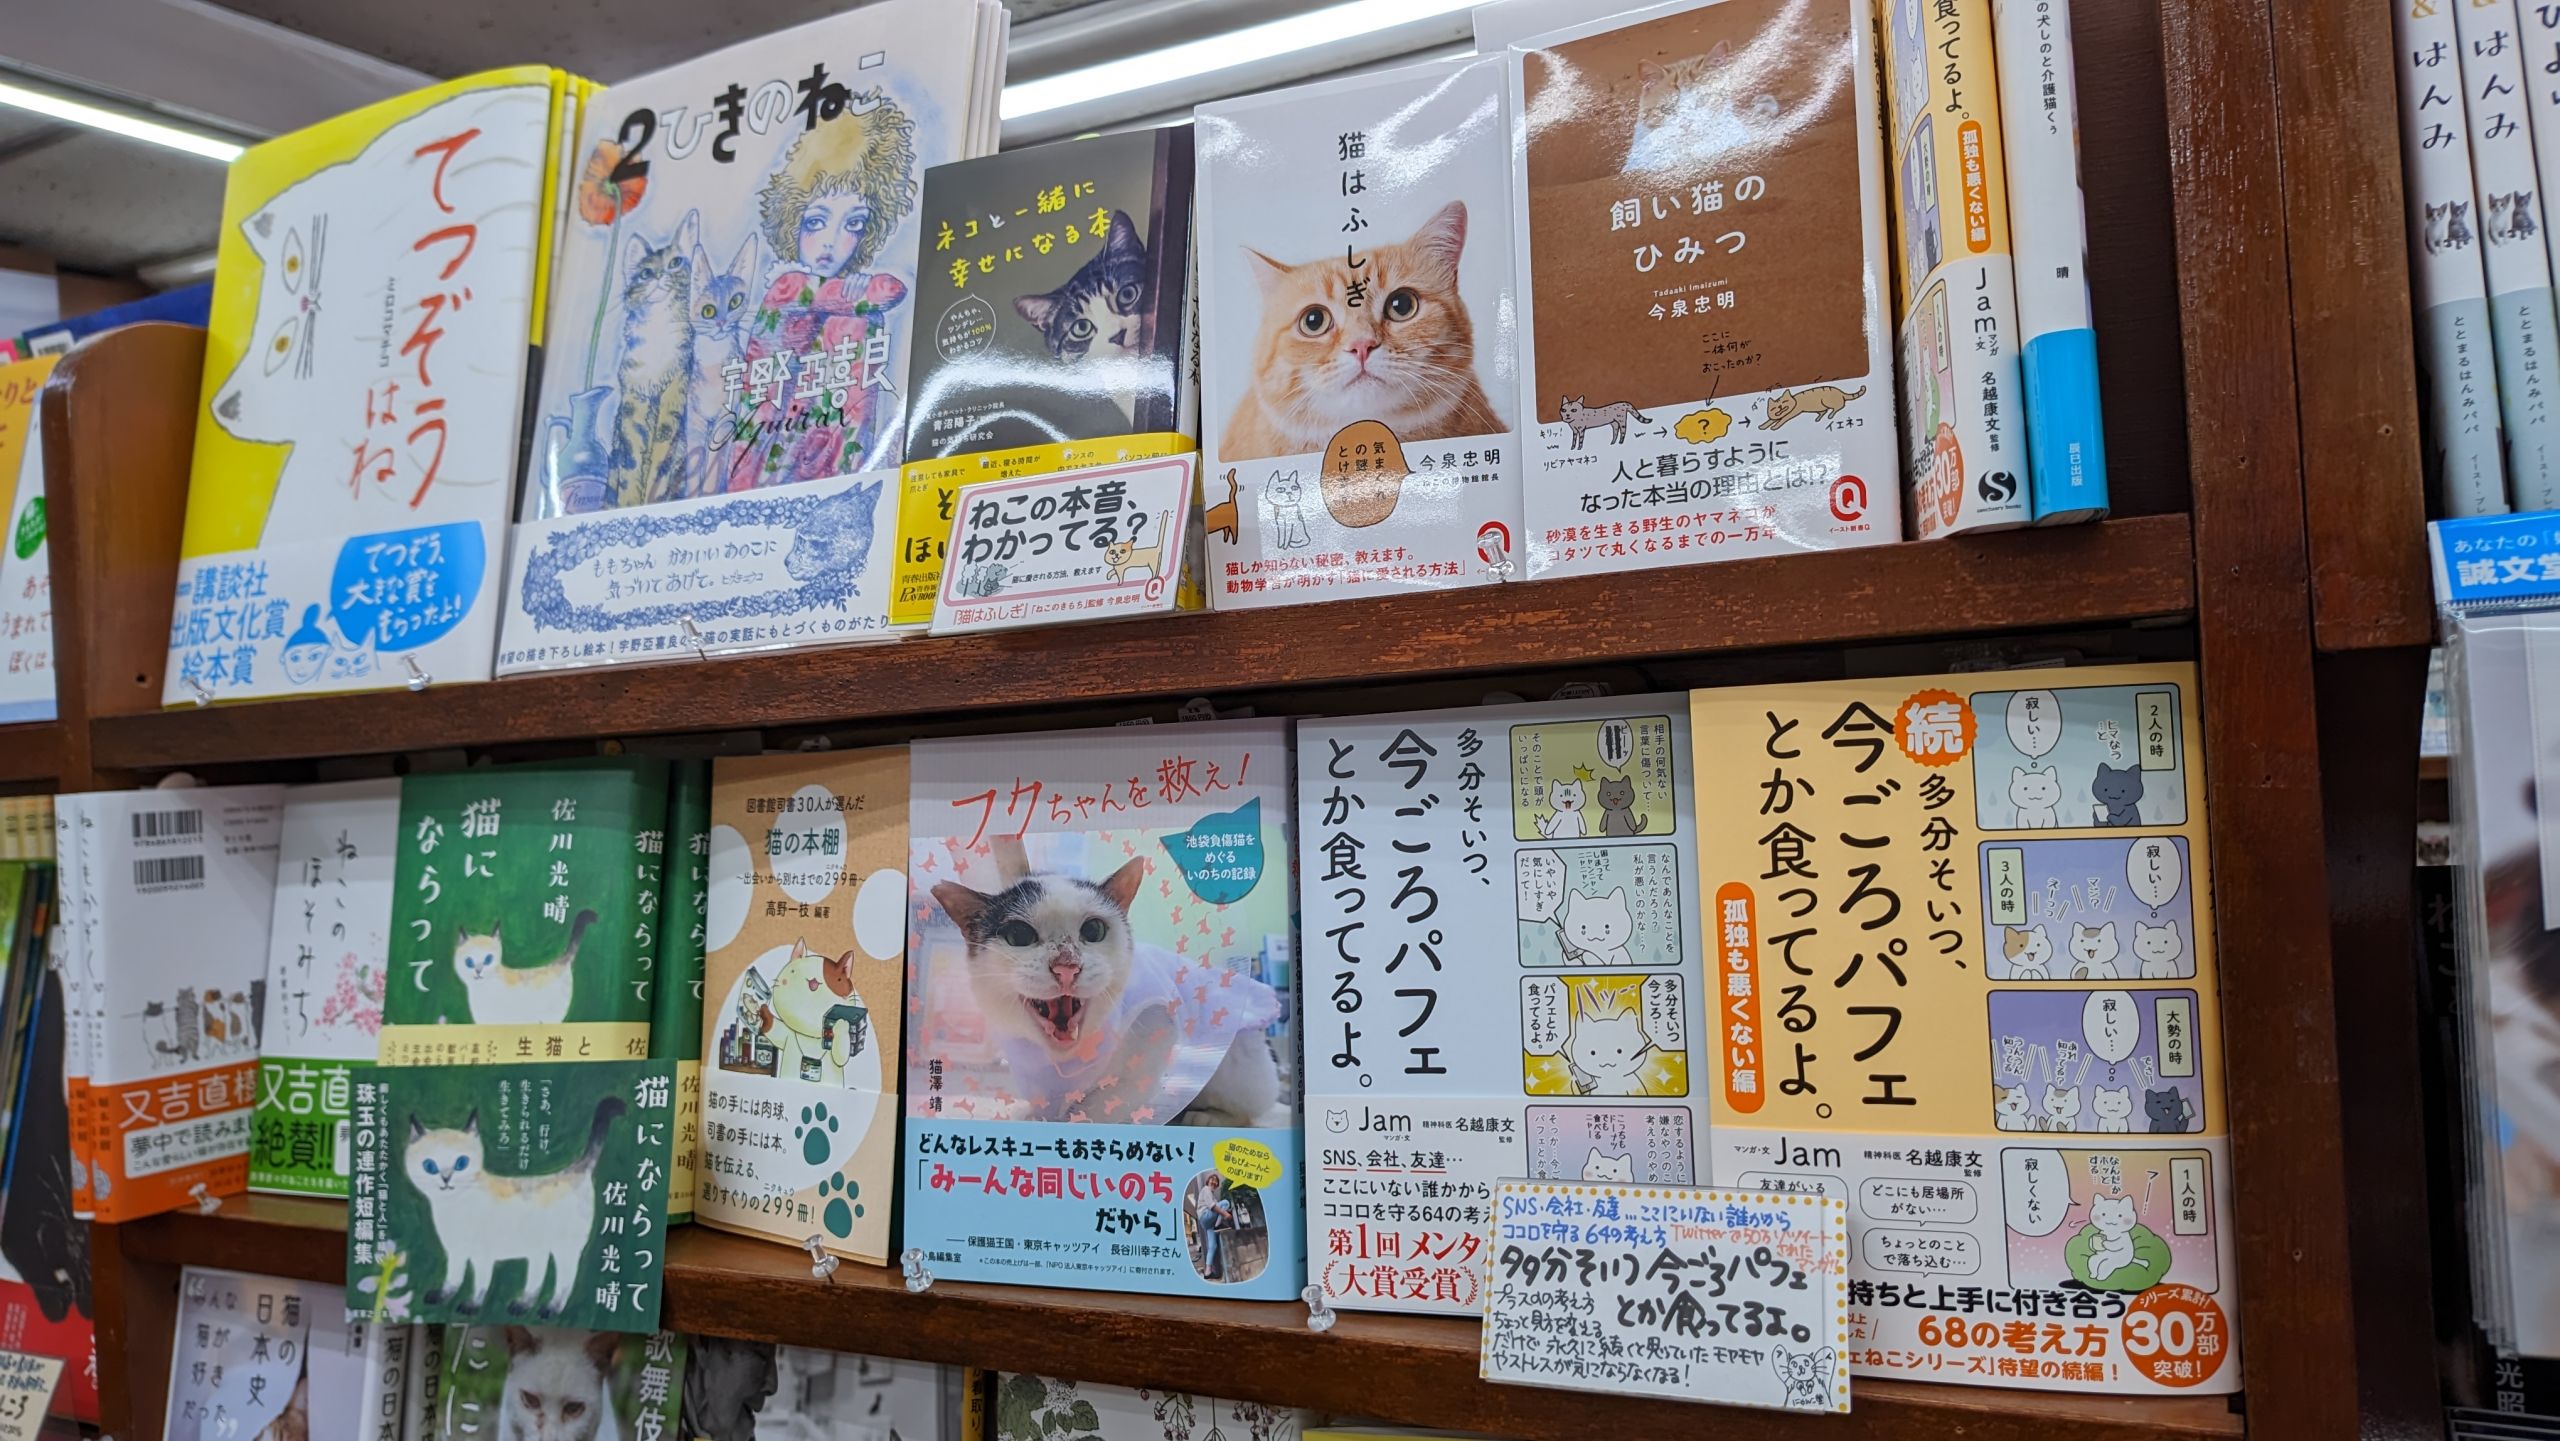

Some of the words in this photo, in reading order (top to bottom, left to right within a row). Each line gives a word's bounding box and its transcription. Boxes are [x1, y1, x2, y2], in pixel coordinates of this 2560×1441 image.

[2413, 41, 2456, 149] はんみ
[2474, 30, 2520, 140] はんみ
[611, 50, 887, 183] 2ひきのねこ
[1609, 174, 1767, 232] 飼い猫の
[1961, 130, 1987, 242] 孤独も悪くない編
[936, 181, 1097, 251] ネコと一緒に
[1338, 131, 1371, 308] 猫はふしぎ
[949, 207, 1112, 289] 幸せになる本
[1634, 230, 1746, 273] ひみつ
[2056, 266, 2069, 279] 晴
[1648, 291, 1735, 321] 今泉忠明
[1653, 284, 1687, 298] Tadaaki
[1974, 267, 1997, 333] Jam
[400, 128, 483, 511] てつぞう
[1702, 331, 1731, 343] ここに
[1702, 340, 1752, 355] 一体何が
[1825, 416, 1864, 432] イエネコ
[1981, 371, 2001, 432] 名越康文
[349, 380, 400, 500] はね
[1419, 448, 1501, 471] 今泉忠明
[1543, 455, 1598, 471] リビアヤマネコ
[1611, 440, 1789, 484] 人と暮らすように
[969, 481, 1138, 531] ねこの本音、
[1581, 463, 1829, 513] なった本当の理由とは!?
[961, 512, 1149, 565] わかってる？
[1546, 505, 1776, 544] 砂漠を生きる野生のヤマネコが
[1548, 525, 1778, 562] コタツで丸くなるまでの一万年
[366, 533, 446, 573] てつぞう、
[593, 556, 656, 578] ももちゃん
[668, 546, 720, 567] かわいい
[724, 540, 777, 560] あのこに
[1225, 546, 1415, 577] 猫しか知らない秘密、教えます。
[192, 560, 269, 605] 講談社
[342, 571, 440, 611] 大きな賞を
[605, 574, 717, 600] 気づいてあげて。
[170, 598, 290, 651] 出版文化賞
[379, 594, 462, 643] もらったよ！
[953, 601, 1030, 626] 『猫はふしぎ』
[180, 646, 258, 689] 絵本賞
[1905, 702, 1964, 757] 続
[2025, 697, 2041, 750] 寂しい…
[2148, 704, 2164, 757] 2人の時
[1518, 735, 1530, 807] いっぱいになる
[1532, 733, 1545, 806] そのことで頭が
[1640, 725, 1653, 812] 言葉に傷ついて…
[1653, 723, 1668, 800] 相手の何気ない
[747, 794, 866, 813] 図書館司書30人が選んだ
[952, 753, 1252, 850] フクちゃんを救え！
[1456, 727, 1491, 886] 多分そいつ、
[460, 798, 502, 878] 猫に
[543, 798, 577, 925] 佐川光晴
[764, 828, 840, 857] 猫の本棚
[1186, 833, 1255, 849] 池袋負傷猫を
[1204, 850, 1237, 865] めぐる
[330, 829, 358, 942] ねこの
[1186, 866, 1257, 882] いのちの記録
[1520, 857, 1530, 901] だって！
[1532, 857, 1544, 912] 気にしすぎ
[1545, 858, 1557, 900] いやいや
[1647, 853, 1660, 931] 言うんだろう？
[1919, 772, 1968, 971] 多分そいつ、
[2000, 861, 2015, 913] 3人の時
[2146, 845, 2161, 899] 寂しい…
[408, 815, 445, 993] ならって
[629, 830, 664, 1001] 猫にならって
[766, 900, 809, 918] 高野一枝
[1320, 738, 1373, 1089] とか食ってるよ。
[1378, 728, 1448, 1075] 今ごろパフェ
[1661, 853, 1676, 953] なんであんなことを
[1758, 710, 1833, 1120] とか食ってるよ。
[1821, 701, 1918, 1106] 今ごろパフェ
[292, 857, 325, 1038] ほそみち
[1528, 983, 1543, 1050] 食ってるよ。
[1543, 983, 1559, 1042] パフェとか
[1648, 979, 1662, 1035] 今ごろ…
[1664, 979, 1680, 1043] 多分そいつ
[1722, 898, 1757, 1095] 孤独も悪くない編
[2102, 999, 2118, 1052] 寂しい…
[2166, 1011, 2183, 1065] 大勢の時
[708, 1090, 789, 1122] 猫の手には肉球、
[1359, 1106, 1412, 1134] Jam
[1422, 1120, 1453, 1129] 精神科医
[1455, 1117, 1516, 1133] 名越康文
[707, 1120, 788, 1154] 司書の手には本。
[918, 1132, 1196, 1164] どんなレスキューもあきらめない！
[1323, 1150, 1463, 1169] SNS、会社、友達…
[1499, 1136, 1513, 1144] 監修
[1673, 1115, 1687, 1183] 恋するように
[1774, 1137, 1842, 1168] Jam
[1864, 1150, 1902, 1161] 精神科医
[1905, 1149, 1983, 1168] 名越康文
[354, 1083, 378, 1265] 珠玉の連作短編集
[704, 1151, 759, 1180] 猫を伝える、
[917, 1159, 1174, 1204] 「みーんな同じいのち
[1323, 1179, 1491, 1200] ここにいない誰かから
[1760, 1179, 1825, 1194] 友達がいる
[1964, 1168, 1982, 1178] 監修
[2109, 1156, 2121, 1194] なんだか
[627, 1075, 670, 1313] 猫にならって
[1872, 1184, 1965, 1201] どこにも居場所
[1891, 1203, 1947, 1215] がない…
[2024, 1158, 2042, 1225] 寂しくない
[2181, 1169, 2197, 1223] 1人の時
[596, 1181, 629, 1314] 佐川光晴
[1095, 1207, 1178, 1241] だから」
[1881, 1236, 1966, 1252] ちょっとのこと
[1110, 1243, 1182, 1259] 長谷川幸子さん
[1884, 1253, 1967, 1269] で落ち込む…
[1338, 1262, 1463, 1302] 大賞受賞
[2140, 1287, 2212, 1309] シリーズ累計！
[277, 1294, 301, 1367] 猫の
[1617, 1289, 1811, 1343] とか食ってるよ。
[1918, 1315, 2110, 1358] 68の考え方
[2125, 1311, 2195, 1358] 30
[190, 1360, 225, 1390] 好き
[246, 1294, 273, 1408] 日本史
[2153, 1360, 2203, 1379] 突破！
